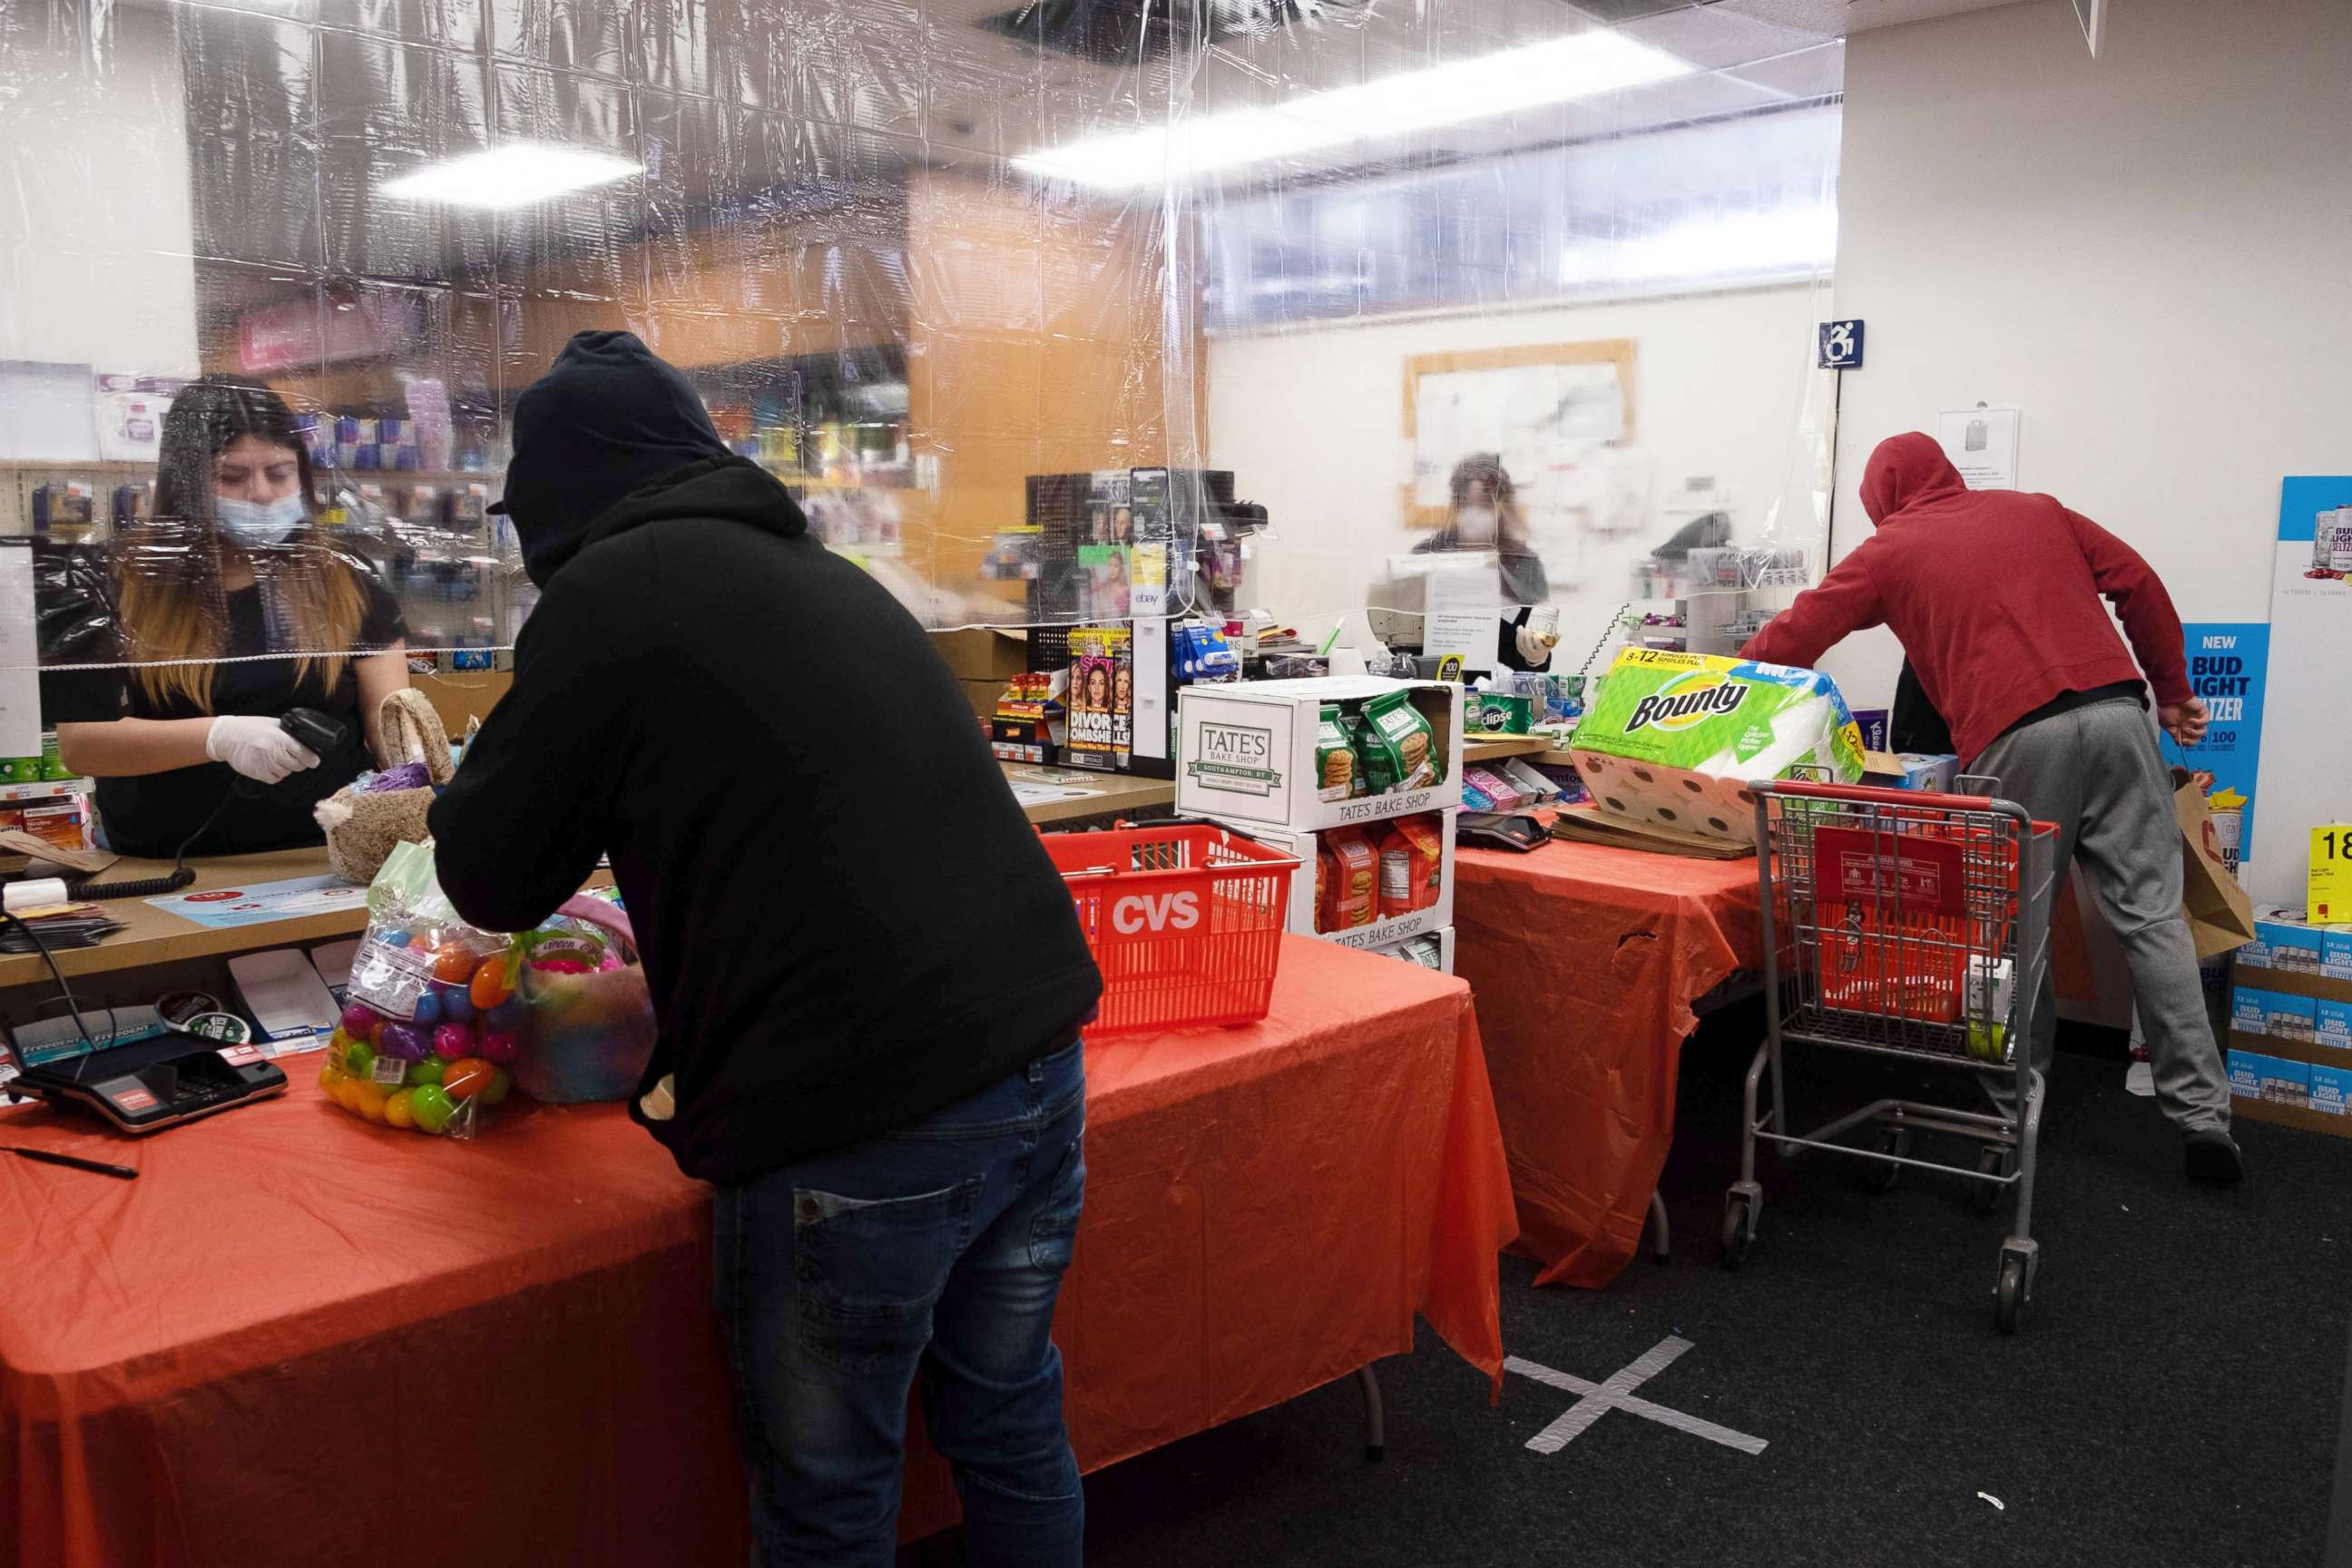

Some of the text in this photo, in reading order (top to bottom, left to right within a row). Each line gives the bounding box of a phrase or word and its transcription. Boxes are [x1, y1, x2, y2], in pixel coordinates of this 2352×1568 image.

[2336, 527, 2352, 535] BU
[1135, 592, 1158, 607] ebay
[2202, 636, 2237, 649] NEW
[1446, 662, 1457, 672] 100
[2191, 656, 2243, 676] BUD
[2193, 677, 2251, 696] IGHT
[1624, 681, 1749, 733] Bounty
[2212, 731, 2236, 742] 100
[1205, 730, 1265, 756] TATE'S
[1210, 751, 1232, 762] BAKE
[1339, 792, 1431, 820] TATE'S BAKE SHOP
[2223, 848, 2240, 859] UD
[1112, 891, 1200, 935] CVS
[1368, 926, 1395, 944] BAKE
[1397, 917, 1422, 936] SHOP
[2328, 950, 2352, 961] BUD
[2239, 1004, 2260, 1014] BUD
[2235, 1010, 2265, 1021] LIGHT
[2324, 1018, 2346, 1028] BUD
[2319, 1024, 2349, 1035] LIGHT
[2233, 1069, 2254, 1079] BUD
[2230, 1074, 2258, 1086] LIGHT
[2317, 1084, 2339, 1094] BUD
[2313, 1091, 2343, 1102] LIGHT
